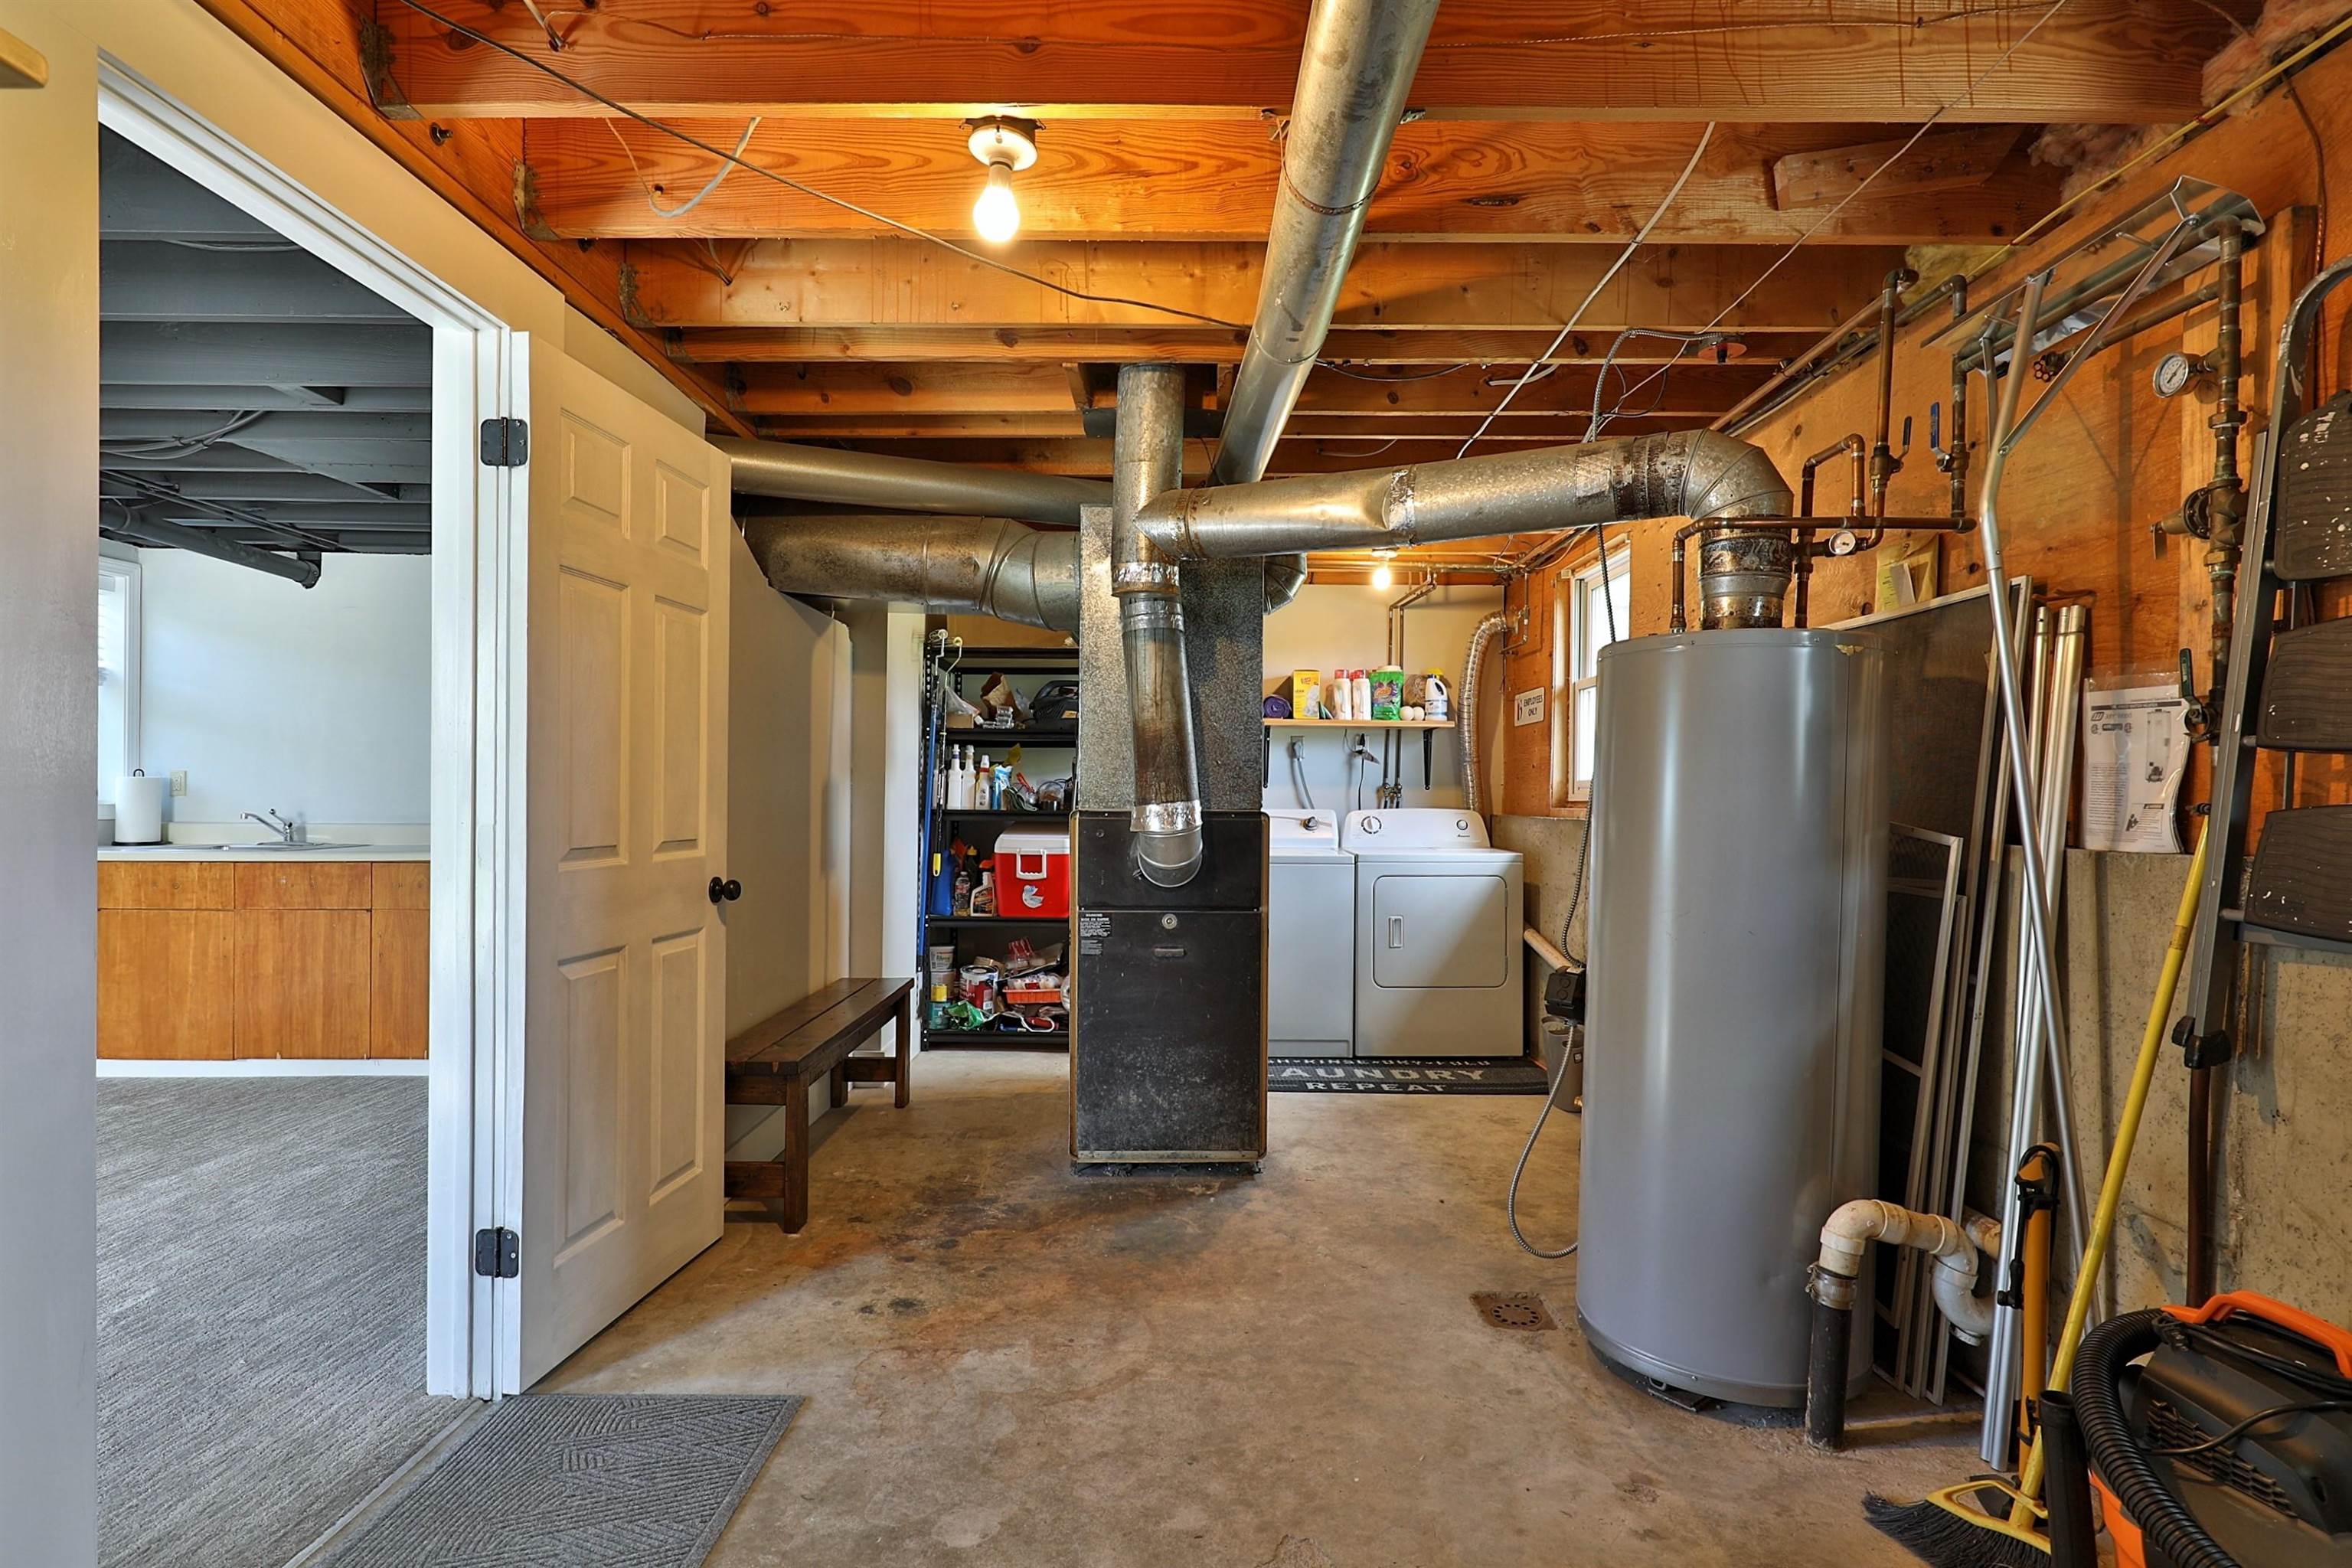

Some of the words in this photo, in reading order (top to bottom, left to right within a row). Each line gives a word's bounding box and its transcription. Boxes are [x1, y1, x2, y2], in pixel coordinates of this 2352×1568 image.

[1524, 694, 1543, 707] EMPLOYEES
[1528, 707, 1537, 717] ONLY
[1305, 1082, 1446, 1092] REPEAT
